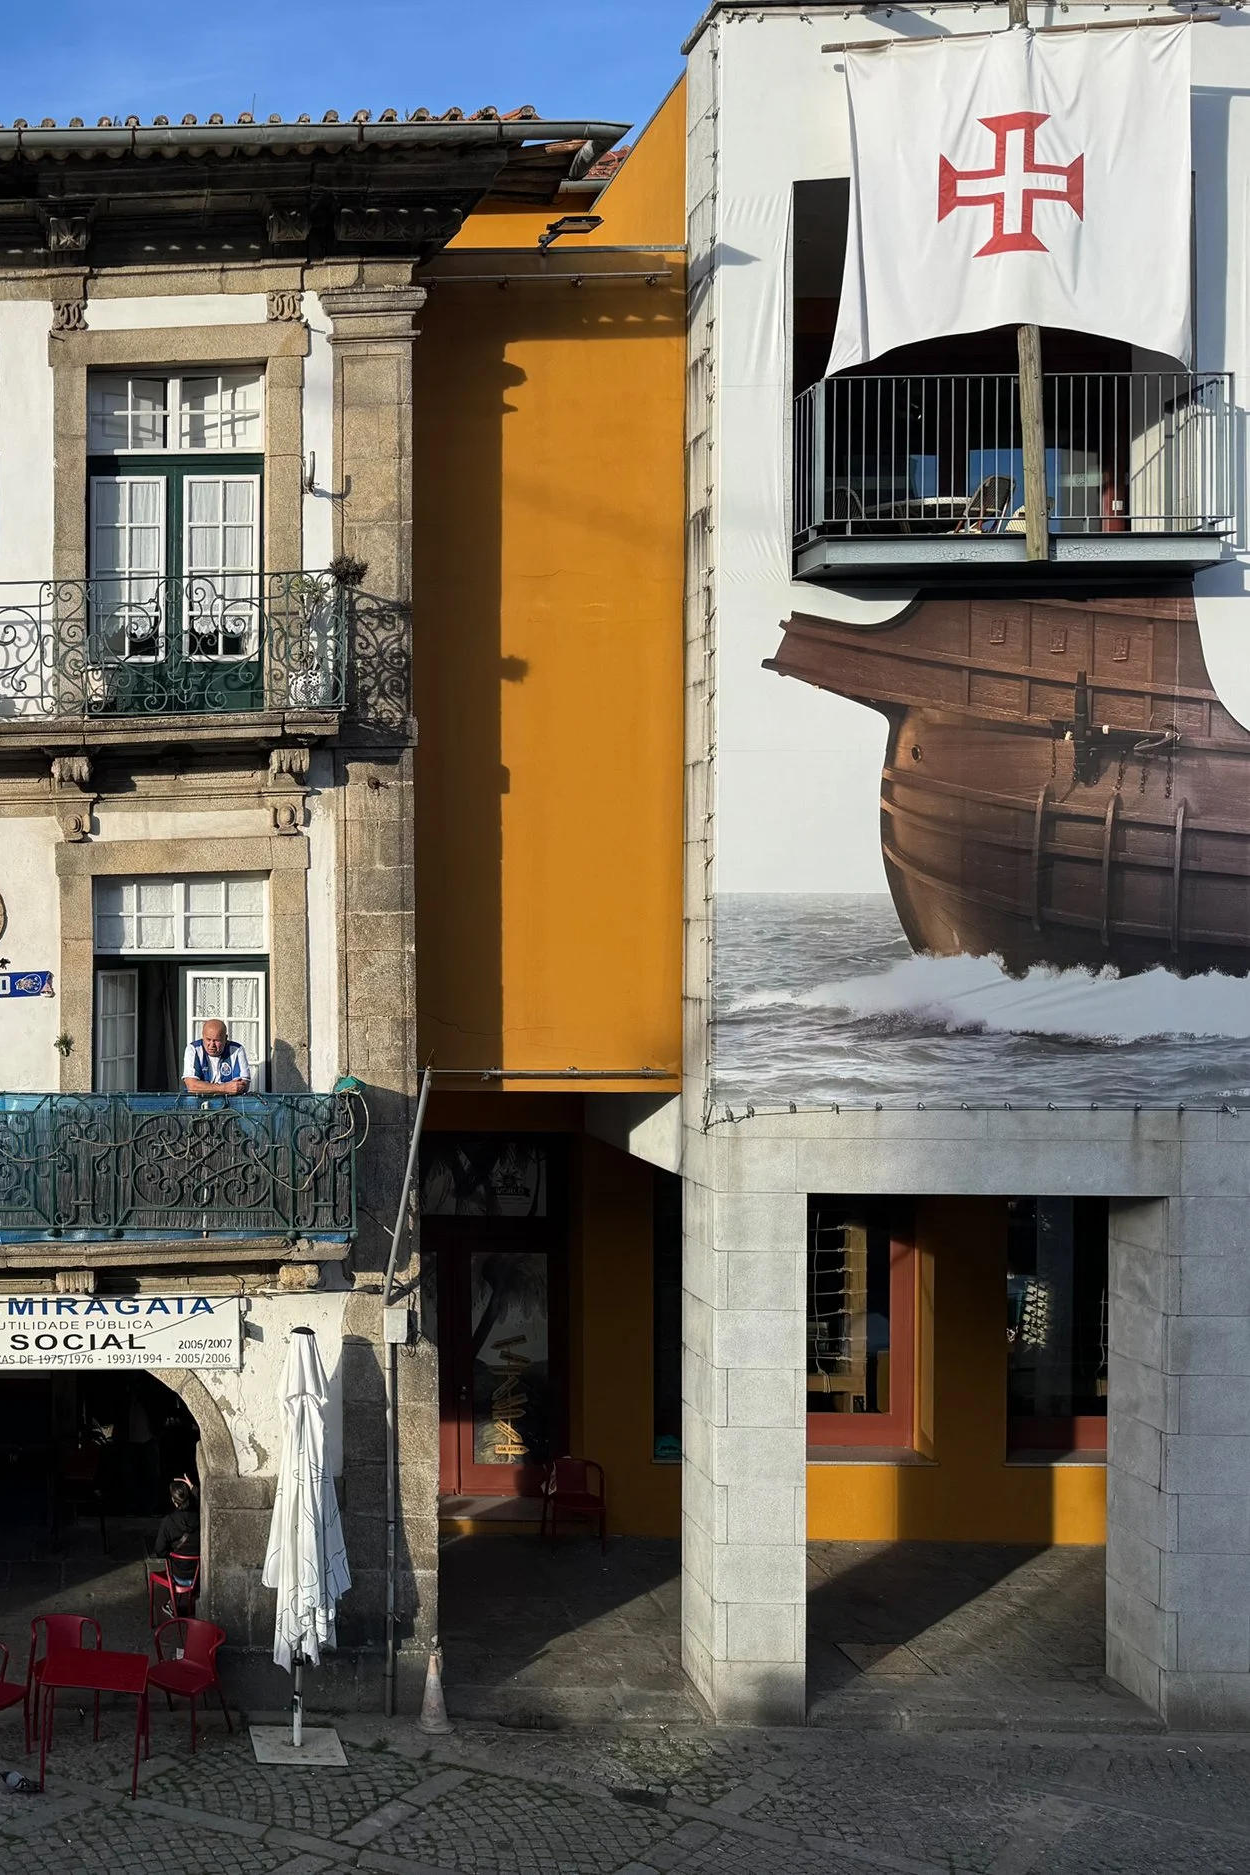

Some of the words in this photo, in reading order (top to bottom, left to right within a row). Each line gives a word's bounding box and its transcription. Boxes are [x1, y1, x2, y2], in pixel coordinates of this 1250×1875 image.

[85, 1319, 154, 1330] PÚBLICA
[10, 1333, 146, 1350] SOCIAL
[19, 1355, 34, 1364] DE
[39, 1354, 94, 1365] 1975/1976
[107, 1354, 162, 1365] 1993/1994
[175, 1353, 231, 1364] 2005/2006
